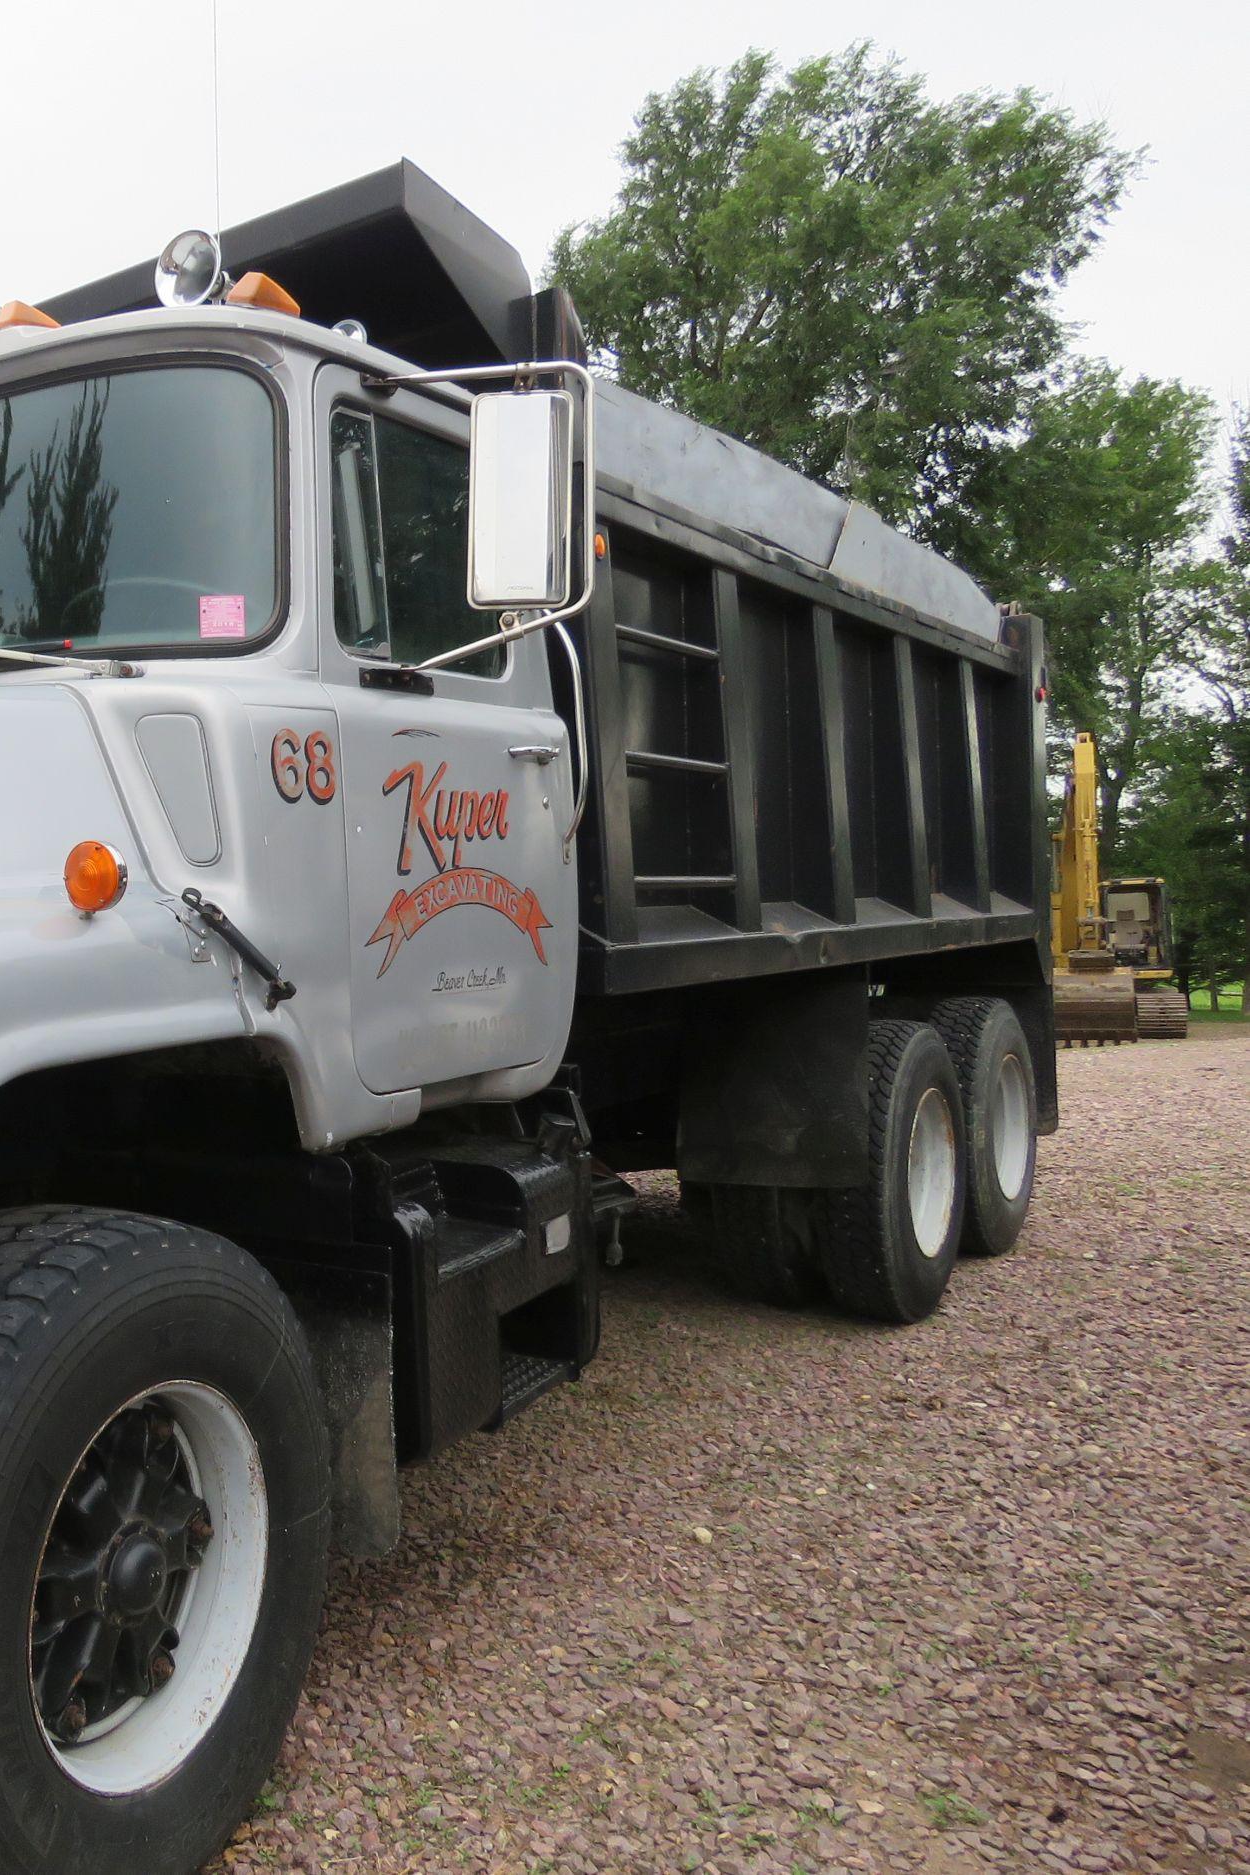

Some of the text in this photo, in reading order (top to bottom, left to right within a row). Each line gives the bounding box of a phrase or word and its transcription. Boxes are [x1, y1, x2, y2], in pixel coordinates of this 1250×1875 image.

[271, 728, 335, 805] 68
[382, 761, 509, 876] Kuper
[415, 875, 519, 920] EXCAVATING
[431, 971, 465, 992] Beaver
